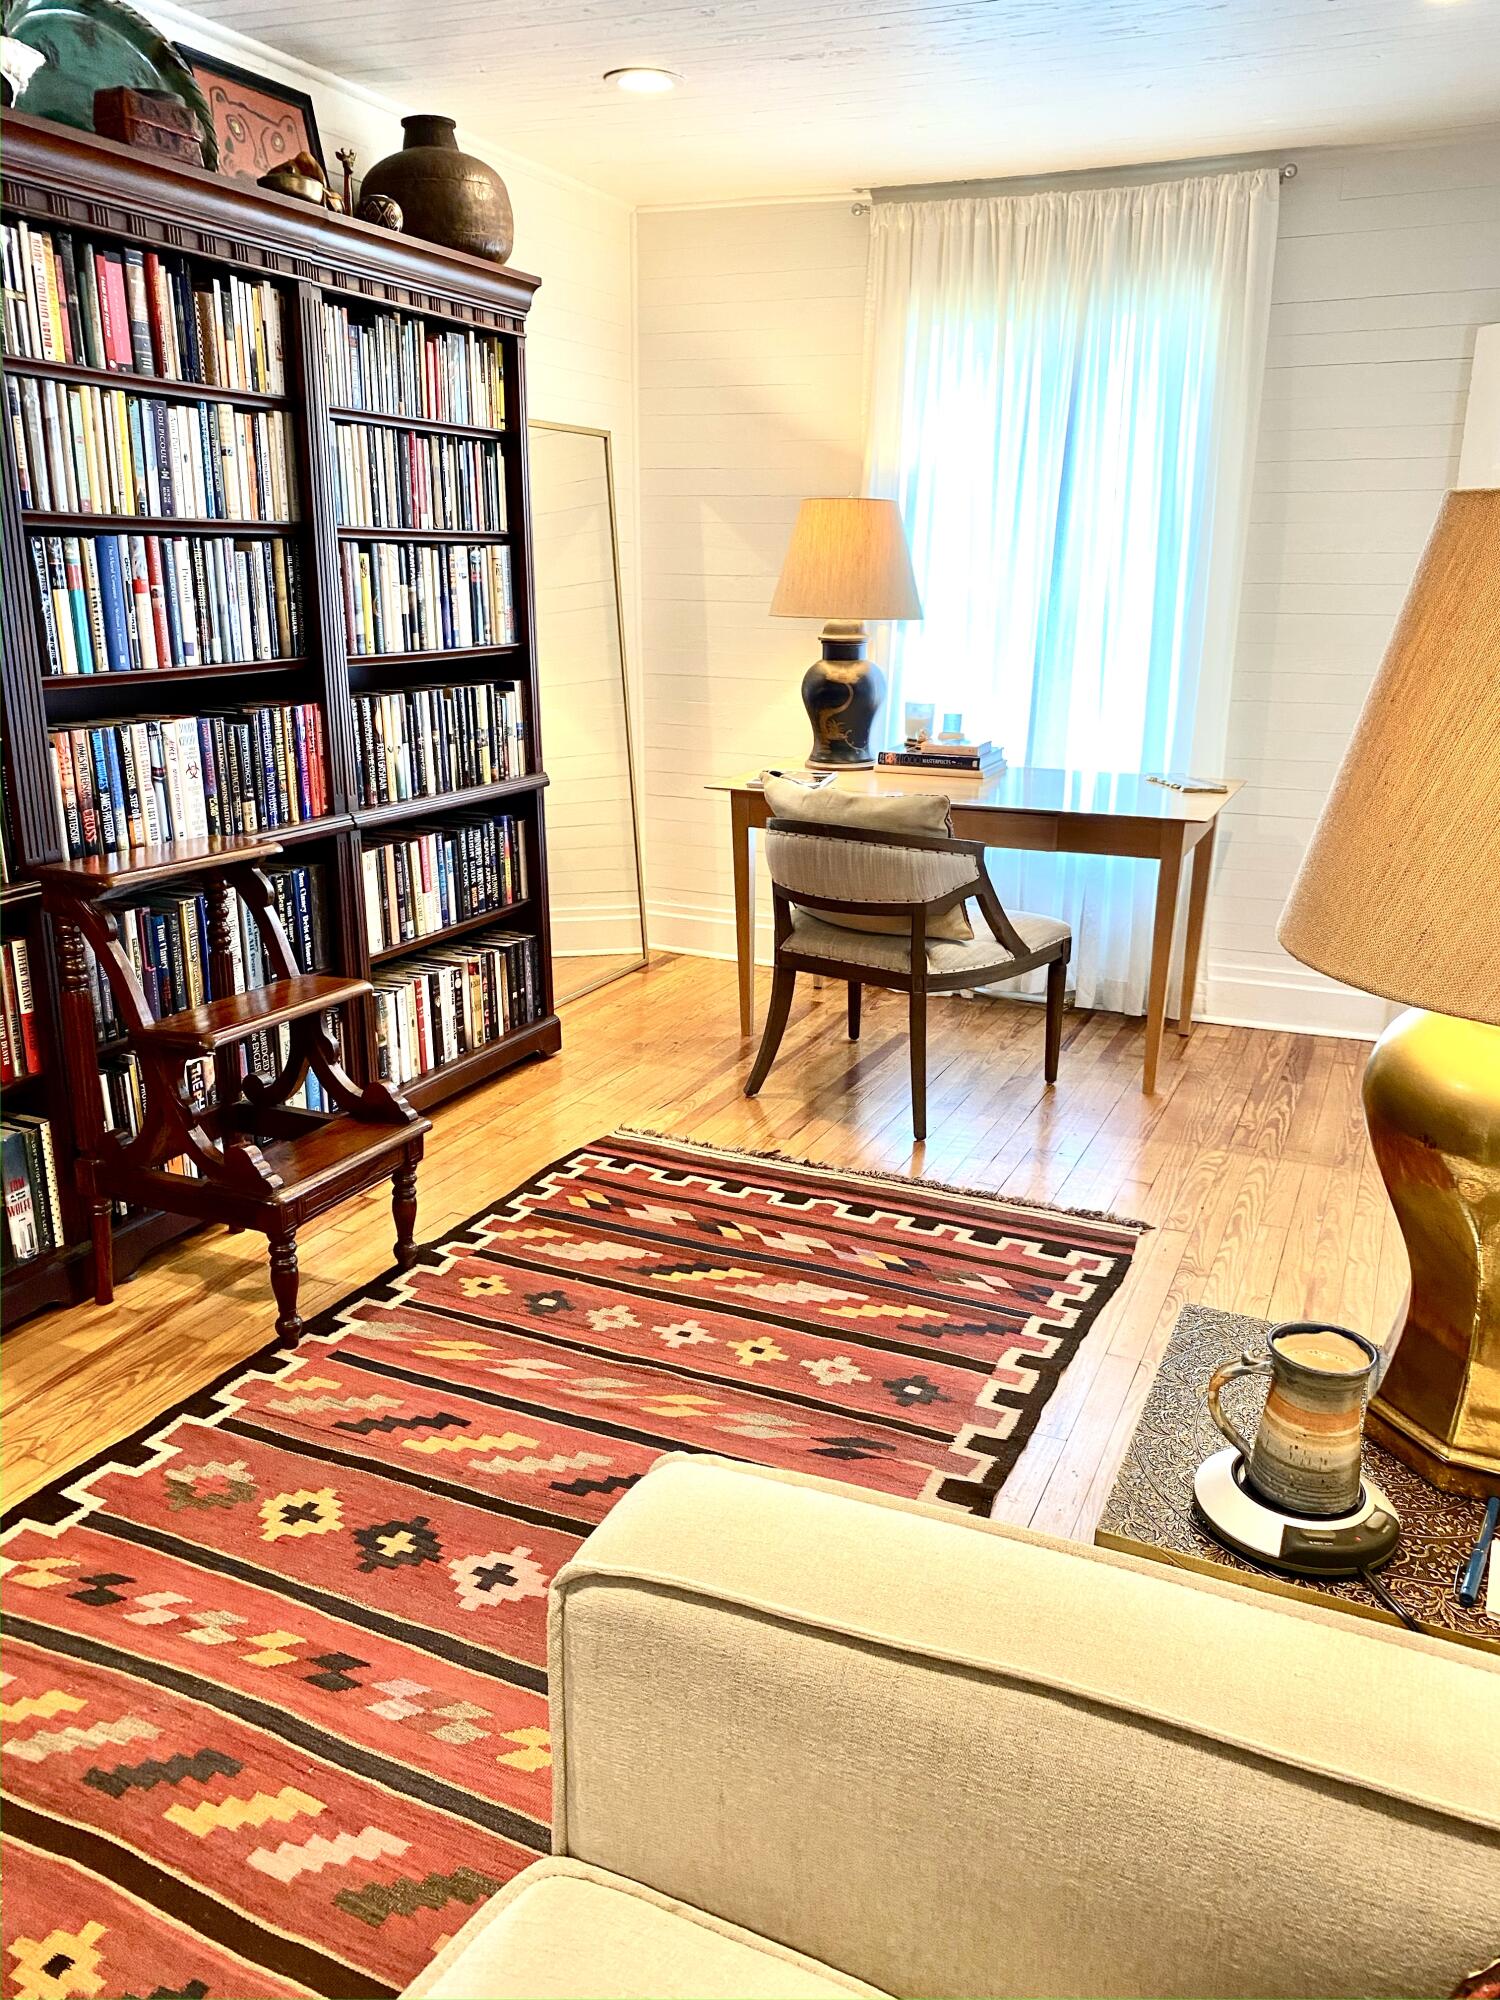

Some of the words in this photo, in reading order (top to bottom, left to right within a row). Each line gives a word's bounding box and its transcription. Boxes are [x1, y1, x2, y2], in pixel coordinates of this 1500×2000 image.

[156, 405, 164, 425] JODI
[158, 428, 168, 465] PICOULT
[109, 557, 117, 574] Moral
[120, 730, 132, 753] JAMES
[137, 728, 149, 756] MICHAEL
[240, 728, 248, 750] DAVID
[263, 730, 274, 768] KELLERMAN
[75, 743, 87, 764] JAMES
[168, 741, 178, 762] PREY
[217, 743, 226, 774] BALDACCI
[376, 743, 384, 760] JOHN
[124, 753, 137, 789] PATTERSON
[230, 756, 240, 793] BALDACCI
[242, 751, 252, 785] BALDACCI
[377, 761, 388, 790] GRISHAM
[79, 763, 92, 800] PATTERSON
[220, 781, 229, 803] SAVING
[266, 771, 276, 793] MOON
[63, 789, 76, 808] JAMES
[99, 792, 112, 811] JAMES
[129, 794, 140, 808] STEP
[146, 796, 154, 805] THE
[268, 795, 278, 816] MUSIC
[147, 807, 156, 820] LOST
[223, 804, 231, 823] FAITH
[66, 809, 81, 845] PATTERSON
[82, 808, 98, 844] CROSS
[102, 811, 116, 844] PATTERSON
[149, 823, 159, 841] WORLD
[460, 833, 468, 860] ROBIN
[276, 878, 284, 892] The
[478, 885, 486, 900] COOK
[278, 893, 286, 912] Bear
[300, 888, 308, 913] Clancy
[187, 905, 197, 928] Tom
[280, 913, 288, 927] and
[302, 915, 310, 933] Debt
[157, 923, 166, 942] Tom
[288, 918, 296, 943] Clancy
[159, 943, 169, 969] Clancy
[189, 929, 199, 964] Clancy
[305, 942, 313, 965] Honor
[16, 946, 29, 977] JEFFERY
[21, 979, 32, 1010] DEAVER
[252, 1042, 262, 1072] ENGLIS
[259, 1030, 270, 1070] ABRIDGED
[191, 1063, 204, 1090] THE
[6, 1198, 32, 1218] WOLFE
